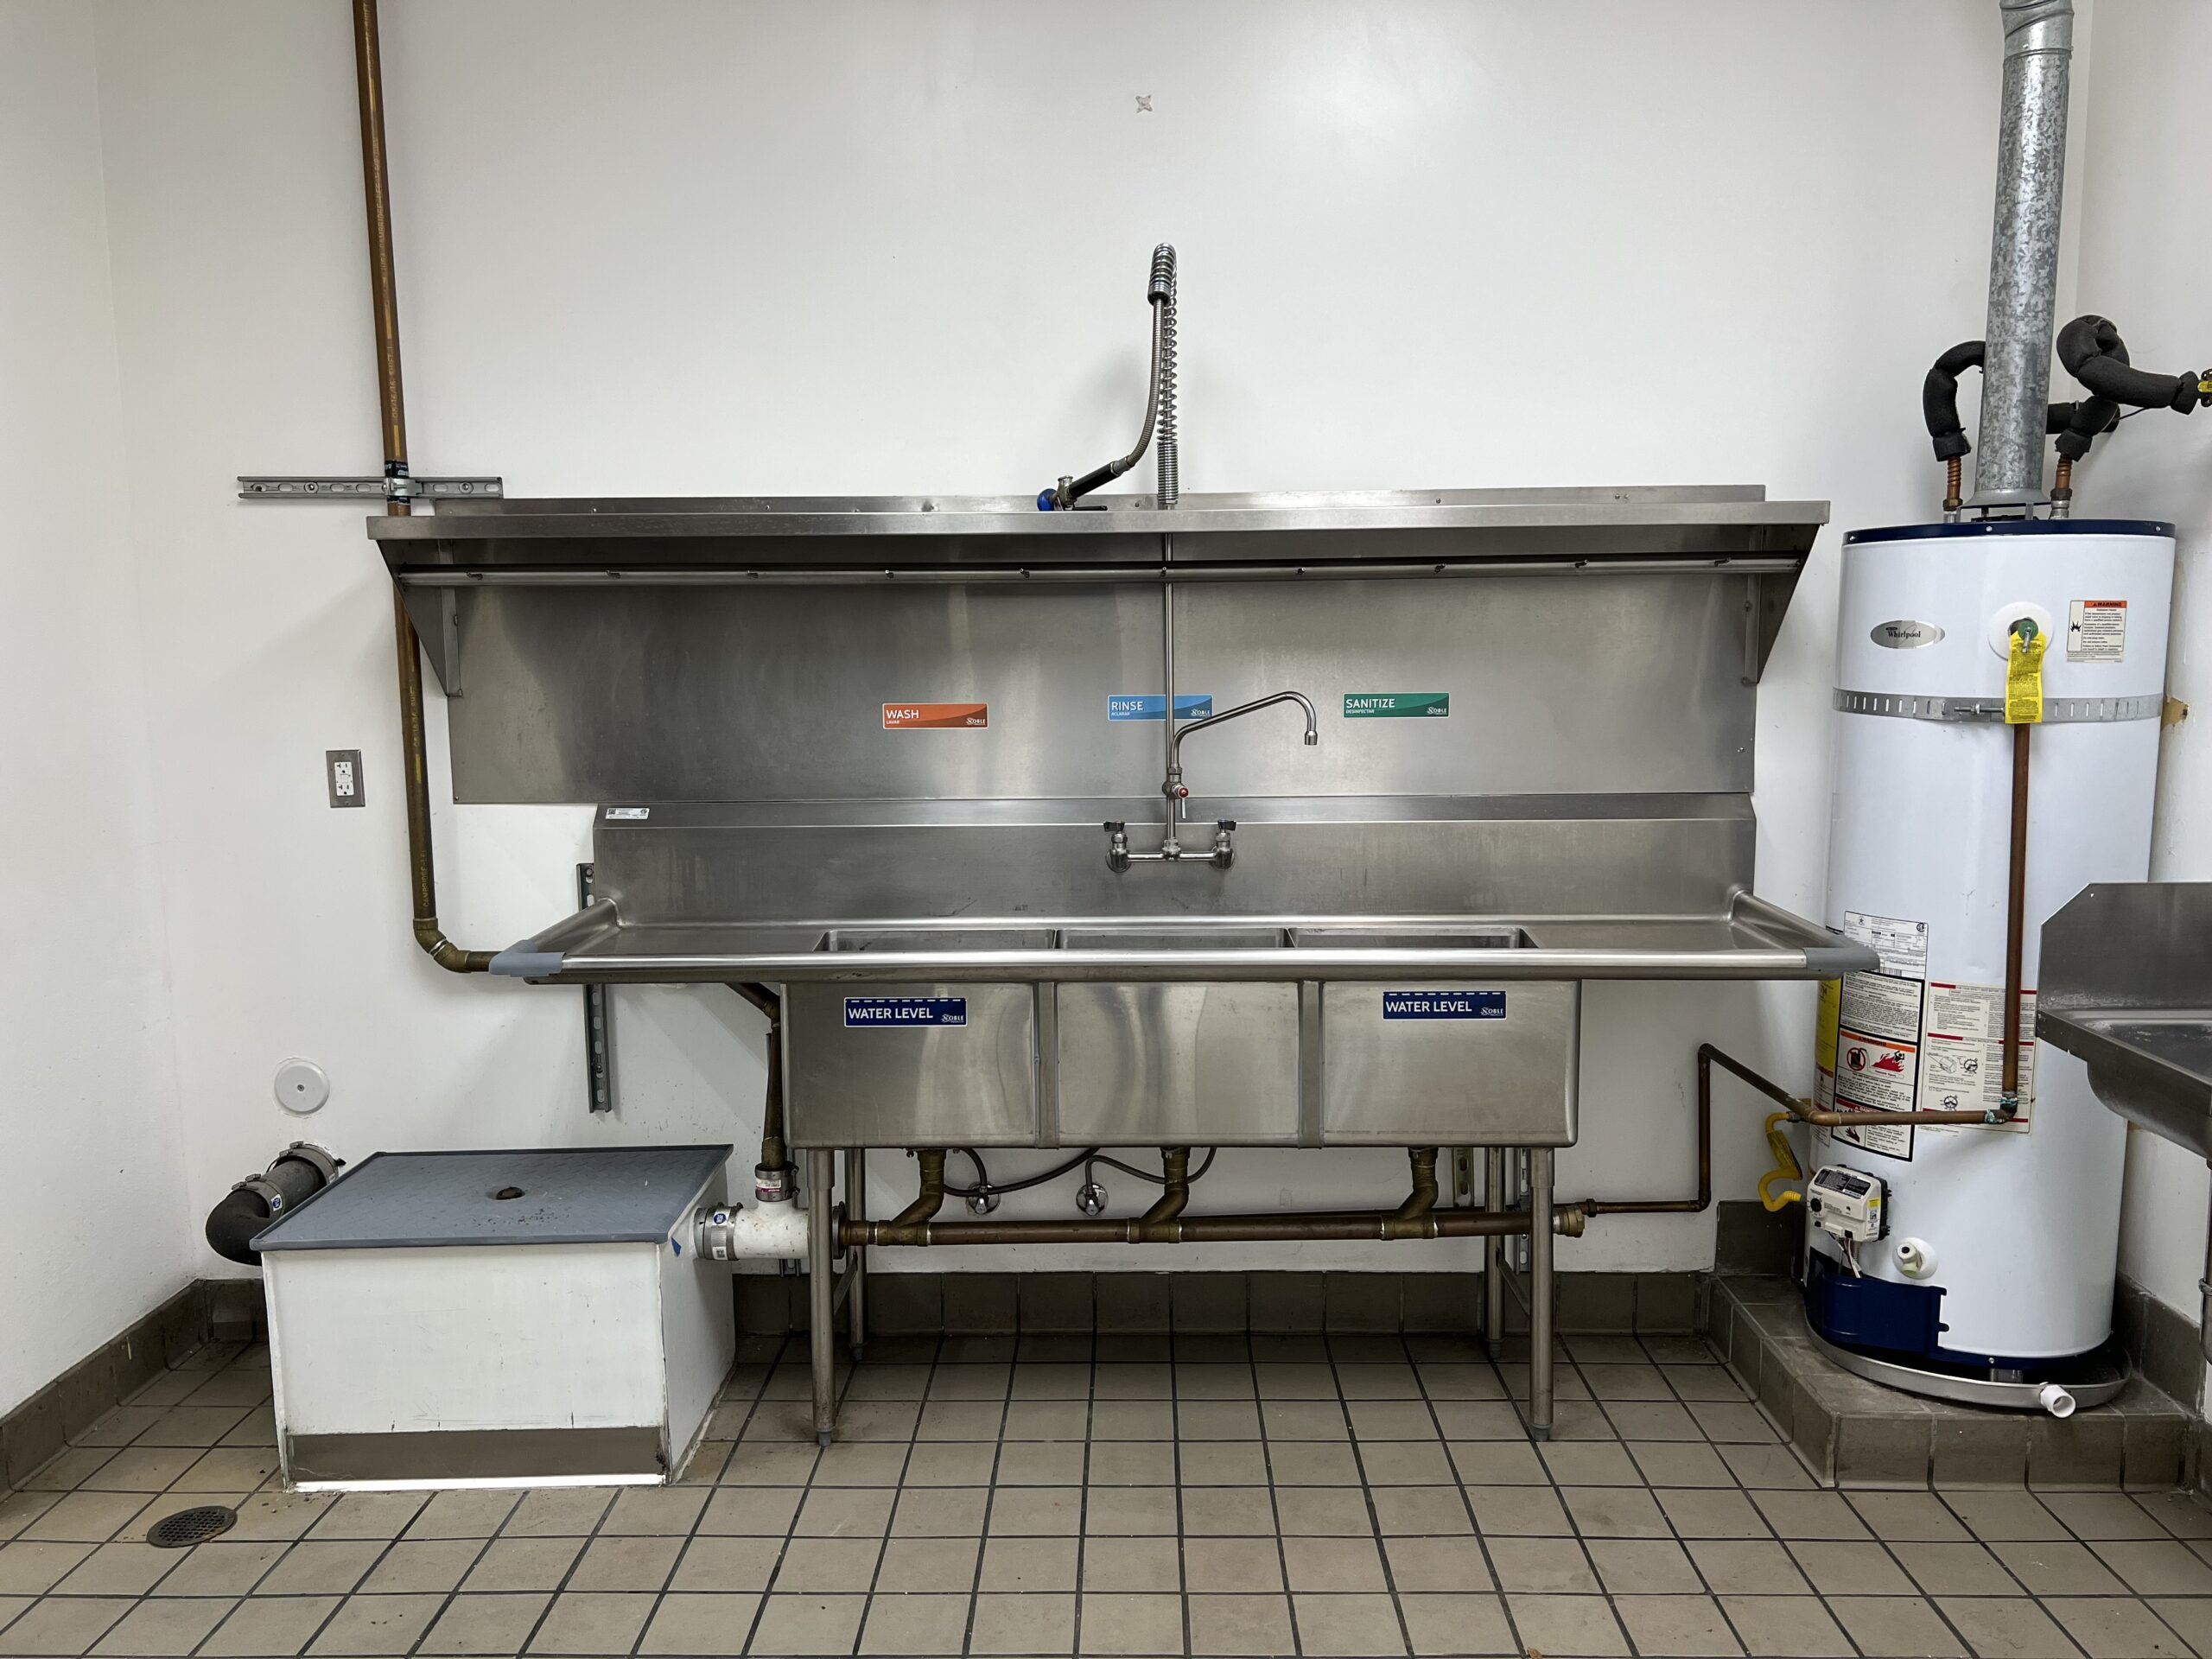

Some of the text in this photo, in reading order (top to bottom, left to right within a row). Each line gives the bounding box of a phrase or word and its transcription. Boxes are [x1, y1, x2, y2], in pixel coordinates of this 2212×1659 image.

[1887, 631, 1921, 639] Whirlpool
[1111, 701, 1143, 710] RINSE
[1345, 698, 1395, 709] SANITIZE
[886, 709, 919, 719] WASH
[1386, 1001, 1472, 1012] WATER LEVEL
[1480, 1007, 1503, 1015] NOBLE
[848, 1007, 933, 1019] WATER LEVEL
[941, 1014, 964, 1022] NOBLE
